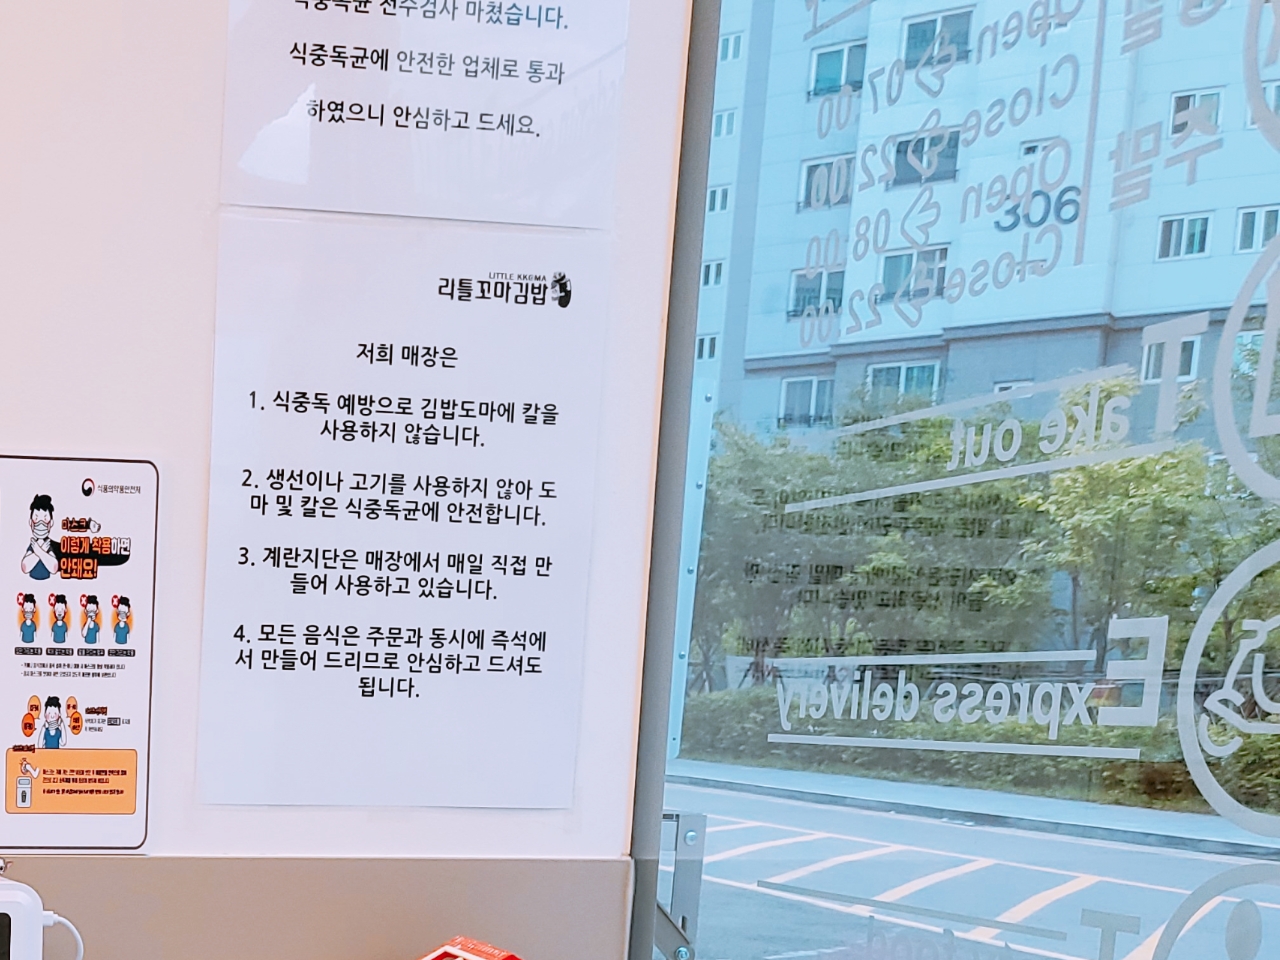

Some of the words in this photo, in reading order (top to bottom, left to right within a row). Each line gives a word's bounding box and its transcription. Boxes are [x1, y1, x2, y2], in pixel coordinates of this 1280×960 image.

[466, 1, 567, 29] 마쳤습니다.
[290, 43, 388, 71] 식중독균에
[397, 51, 455, 76] 안전한
[463, 56, 519, 80] 업체로
[526, 61, 565, 85] 통과
[306, 100, 384, 126] 하였으니
[394, 106, 469, 131] 안심하고
[476, 113, 539, 137] 드세요.
[993, 185, 1081, 232] 306
[439, 275, 548, 305] 리틀꼬마김밥
[357, 343, 393, 365] 저희
[402, 346, 458, 368] 매장은
[250, 391, 264, 410] 1.
[273, 391, 330, 414] 식중독
[337, 394, 413, 416] 예방으로
[421, 398, 514, 423] 김밥도마에
[523, 403, 558, 425] 칼을
[321, 419, 395, 443] 사용하지
[405, 424, 484, 447] 않습니다.
[242, 469, 258, 488] 2.
[267, 469, 343, 492] 생선이나
[349, 473, 406, 495] 고기를
[413, 475, 487, 498] 사용하지
[497, 479, 533, 500] 않아
[539, 482, 557, 498] 도
[251, 494, 268, 515] 마
[277, 495, 292, 516] 및
[301, 496, 338, 518] 칼은
[346, 498, 439, 522] 식중독균에
[447, 502, 545, 526] 안전합니다.
[60, 537, 90, 555] 이렇게
[92, 537, 130, 555] 착용하면
[60, 558, 97, 579] 안돼요!
[238, 547, 255, 566] 3.
[263, 547, 358, 569] 계란지단은
[366, 550, 439, 573] 매장에서
[448, 553, 482, 574] 매일
[492, 555, 526, 575] 직접
[536, 557, 552, 576] 만
[290, 573, 327, 595] 들어
[335, 575, 410, 596] 사용하고
[418, 577, 496, 600] 있습니다.
[234, 625, 250, 643] 4.
[258, 625, 296, 644] 모든
[303, 625, 360, 646] 음식은
[367, 627, 423, 648] 주문과
[429, 628, 484, 650] 동시에
[491, 631, 546, 652] 즉석에
[235, 649, 252, 669] 서
[262, 649, 316, 671] 만들어
[324, 651, 399, 672] 드리므로
[408, 653, 480, 674] 안심하고
[487, 656, 542, 676] 드셔도
[359, 677, 419, 698] 됩니다.
